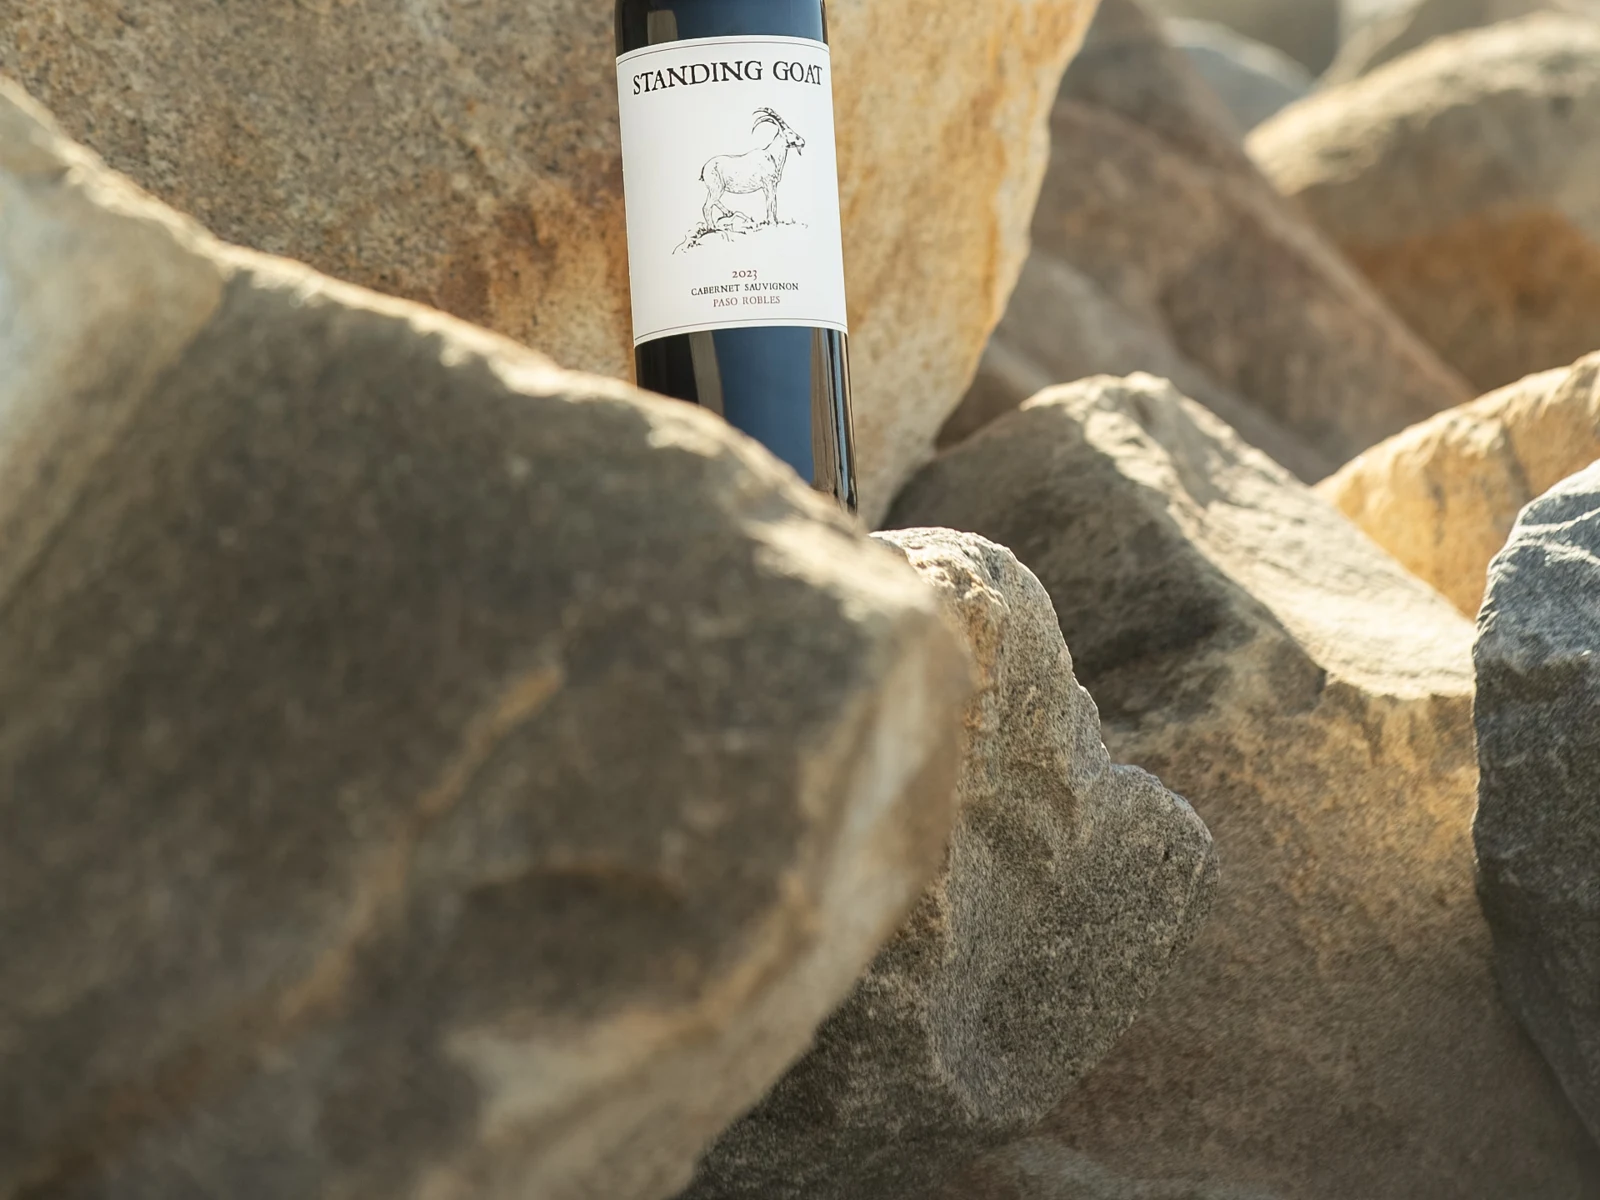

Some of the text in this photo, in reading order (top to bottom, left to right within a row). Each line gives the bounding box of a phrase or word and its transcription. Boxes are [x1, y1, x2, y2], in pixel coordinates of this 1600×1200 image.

[632, 60, 823, 95] STANDING GOAT
[731, 269, 758, 281] 2023
[690, 282, 800, 296] CABERNET SAUVIGNON
[712, 295, 781, 308] PASO ROBLES
